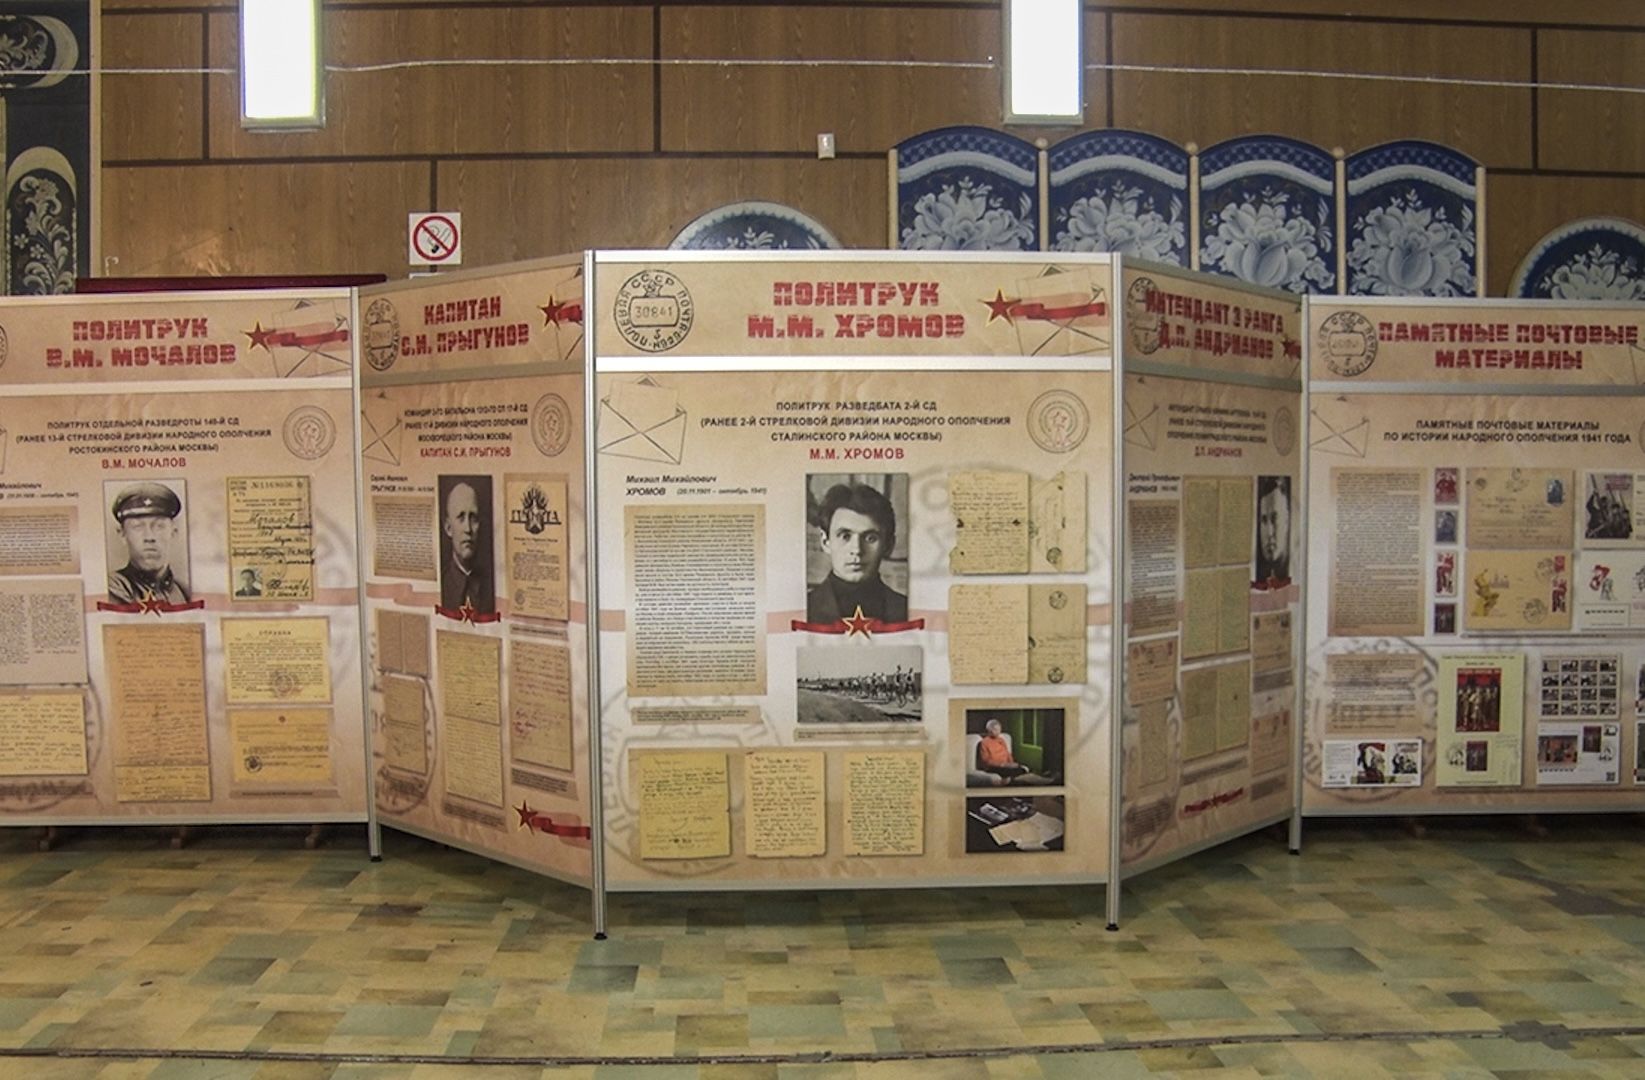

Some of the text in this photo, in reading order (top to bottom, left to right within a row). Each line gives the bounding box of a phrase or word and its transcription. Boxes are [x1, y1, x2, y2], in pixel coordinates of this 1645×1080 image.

[630, 273, 675, 289] СССР
[773, 282, 939, 306] ПОЛИТРУК
[424, 295, 501, 325] КАПИТАН
[1145, 288, 1230, 326] ИНТЕНДАНТ
[1233, 306, 1241, 328] 3
[73, 317, 208, 341] ПОЛИТРУК
[748, 314, 965, 338] М.М. ХРОМОВ
[401, 323, 530, 357] С.И. ПРЫГУНОВ
[1379, 322, 1639, 345] ПАМЯТНЫЕ ПОЧТОВЫЕ
[46, 344, 236, 368] В.М. МОЧАЛОВ
[1435, 349, 1582, 369] МАТЕРИАЛЫ
[776, 400, 937, 411] ПОЛИТРУК РАЗВЕДБАТА 2-Й СД
[47, 421, 90, 429] ПОЛИТРУК
[92, 419, 143, 429] ОТДЕЛЬНОЙ
[145, 419, 202, 427] РАЗВЕДРОТЫ
[227, 417, 239, 425] СД
[700, 416, 1011, 428] (РАНЕЕ 2-Й СТРЕЛКОВОЙ ДИВИЗИИ НАРОДНОГО ОПОЛЧЕНИЯ
[1416, 420, 1599, 430] ПАМЯТНЫЕ ПОЧТОВЫЕ МАТЕРИАЛЫ
[16, 435, 46, 444] (РАНЕЕ
[66, 432, 122, 442] СТРЕЛКОВОЙ
[123, 432, 164, 441] ДИВИЗИИ
[166, 430, 217, 439] НАРОДНОГО
[219, 429, 272, 438] ОПОЛЧЕНИЯ
[771, 431, 943, 443] СТАЛИНСКОГО РАЙОНА МОСКВЫ)
[1384, 432, 1631, 443] ПО ИСТОРИИ НАРОДНОГО ОПОЛЧЕНИЯ 1941 ГОДА
[69, 443, 219, 454] РОСТОКИНСКОГО РАЙОНА МОСКВЫ)
[469, 446, 512, 457] ПРЫГУНОВ
[809, 448, 905, 460] М.М. ХРОМОВ
[102, 457, 187, 469] В.М. МОЧАЛОВ
[661, 475, 717, 483] Михайлович
